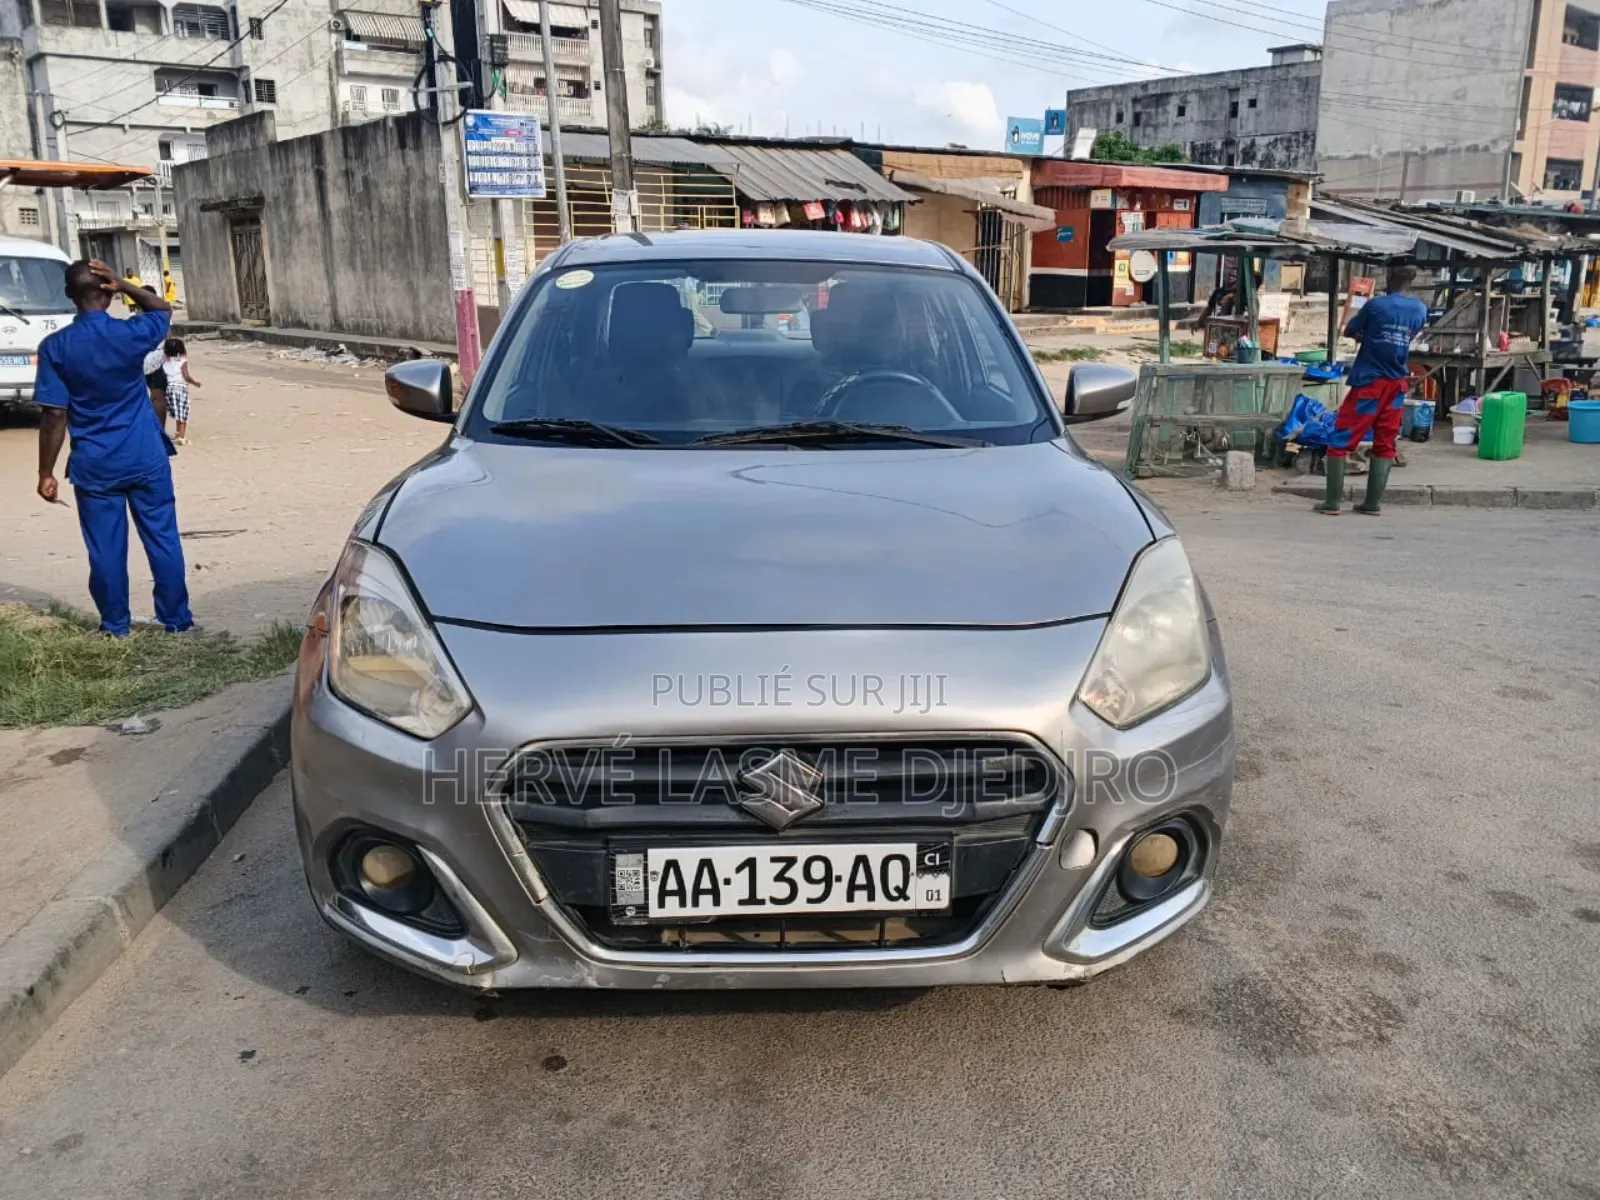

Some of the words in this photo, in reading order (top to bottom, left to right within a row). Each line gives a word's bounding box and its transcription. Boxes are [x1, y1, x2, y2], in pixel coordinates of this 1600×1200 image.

[43, 319, 58, 330] 75
[924, 853, 941, 867] CI
[925, 889, 942, 902] 01
